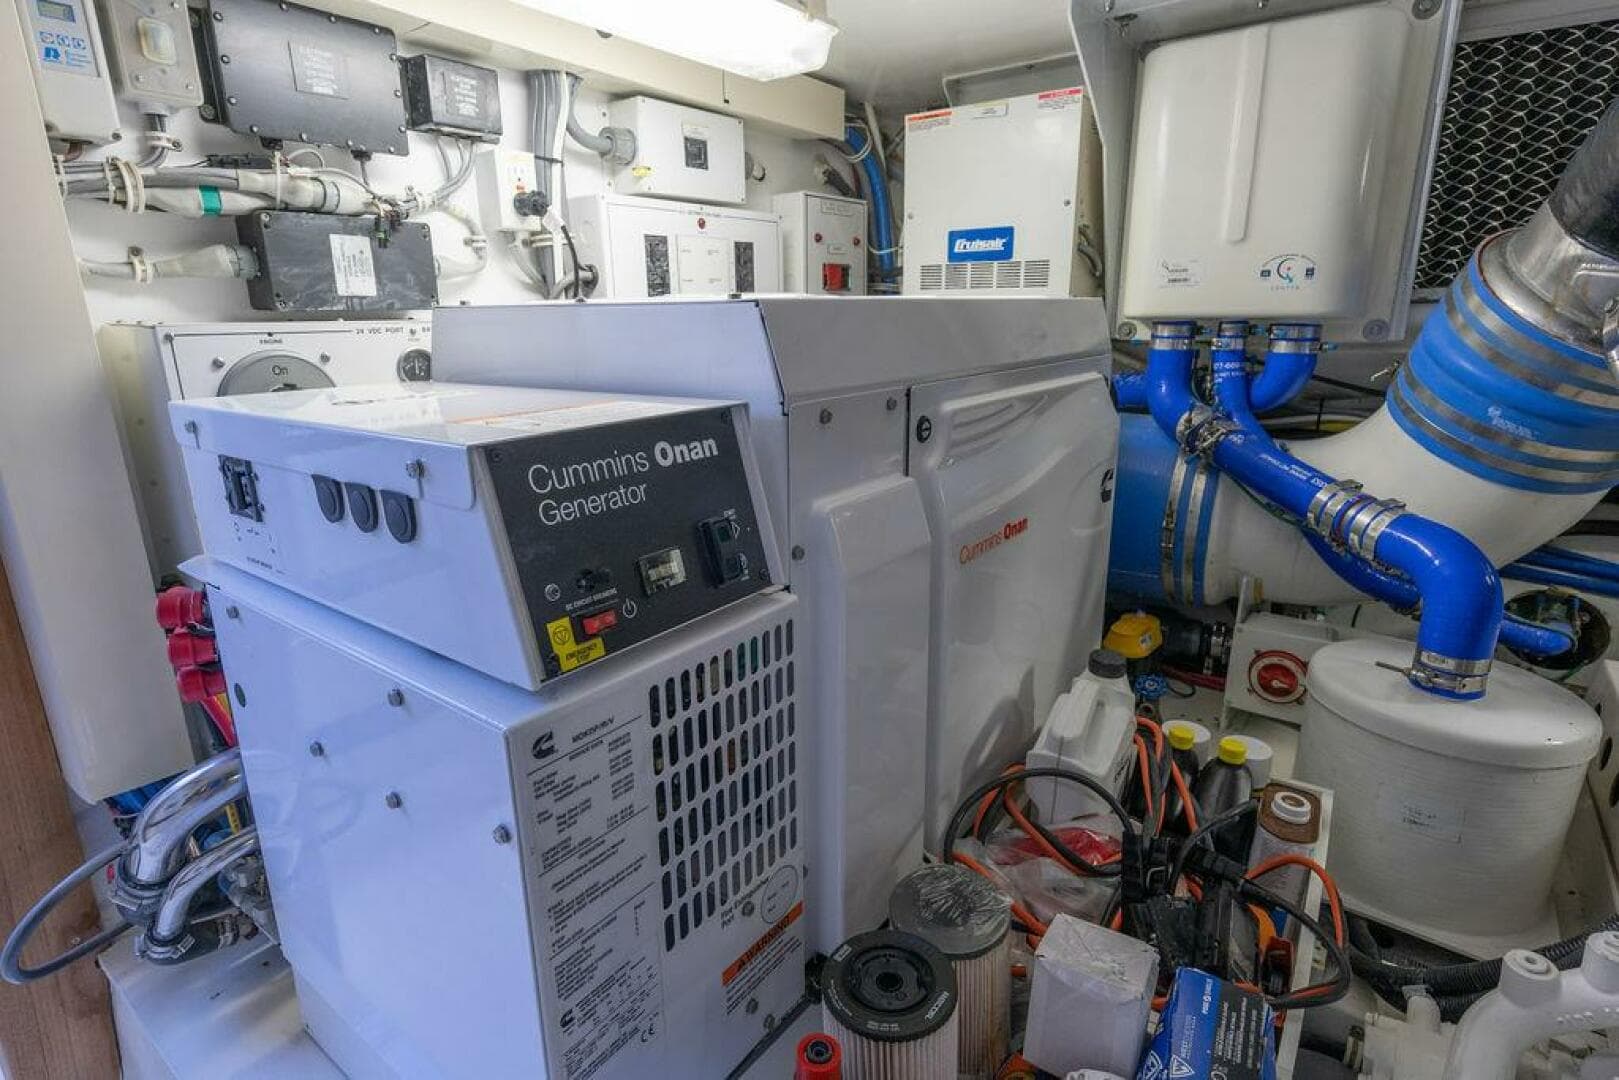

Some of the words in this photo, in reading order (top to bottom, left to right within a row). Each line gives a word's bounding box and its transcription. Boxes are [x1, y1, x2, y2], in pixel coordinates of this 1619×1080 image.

[271, 364, 289, 377] On
[528, 450, 649, 494] Cummins
[653, 437, 719, 468] Onan
[538, 483, 648, 525] Generator
[959, 532, 1003, 564] Cummins
[1003, 518, 1028, 539] Onan
